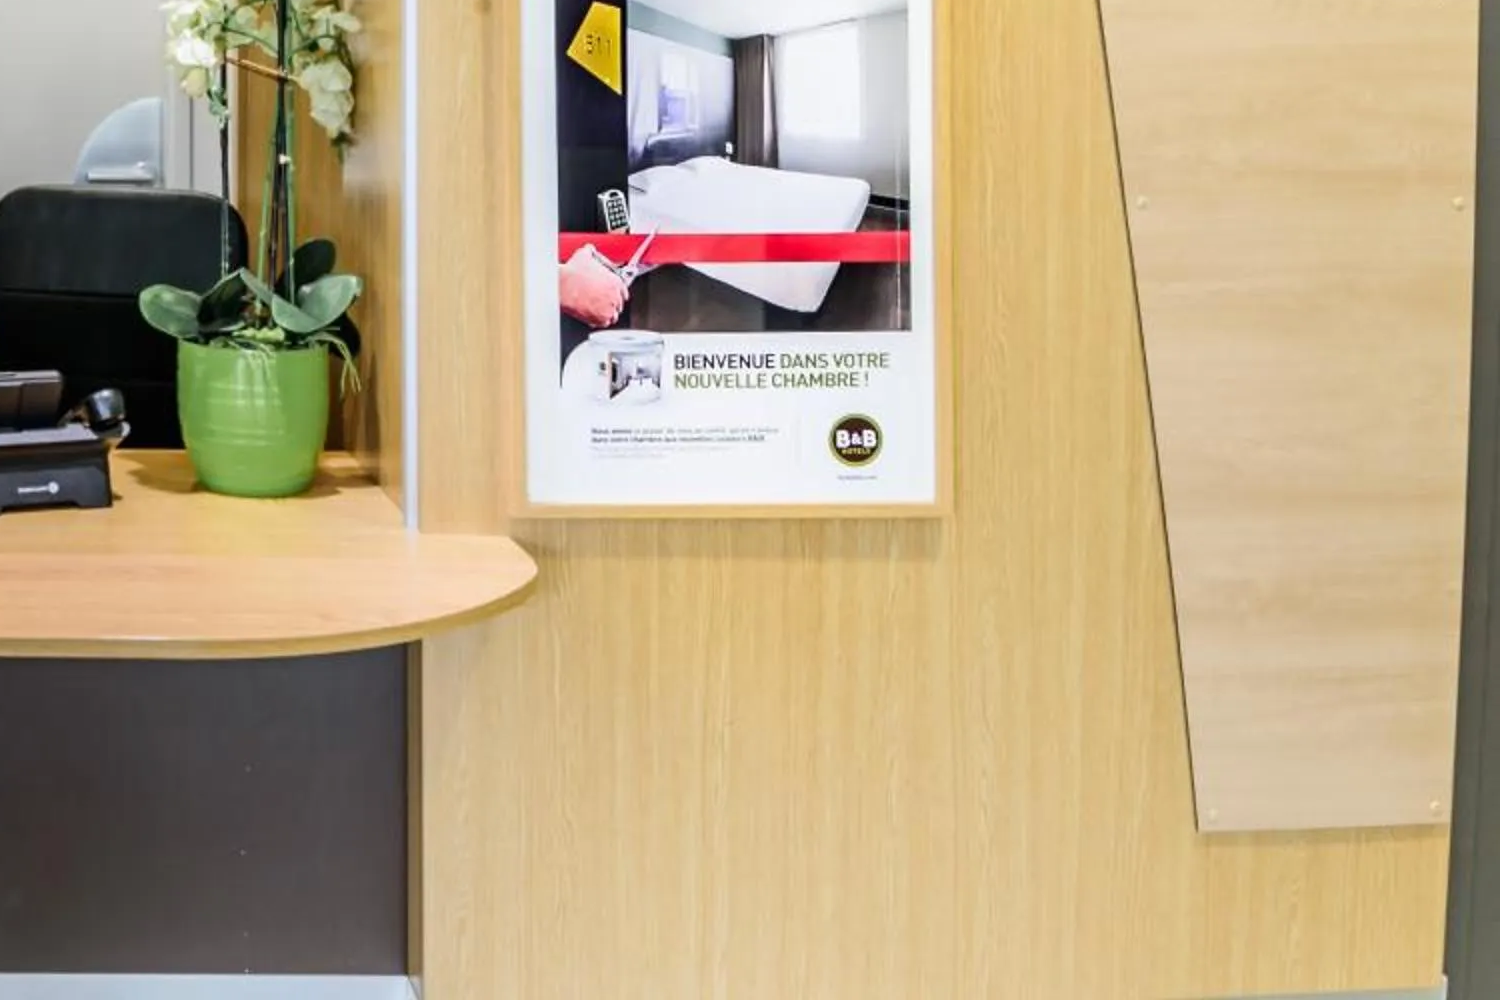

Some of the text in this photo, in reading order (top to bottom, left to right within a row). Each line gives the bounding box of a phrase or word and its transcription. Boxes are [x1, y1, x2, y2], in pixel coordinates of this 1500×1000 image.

[673, 352, 890, 371] BIENVENUE DANS VOTRE
[673, 371, 870, 390] NOUVELLE CHAMBRE !
[835, 429, 877, 449] B&B
